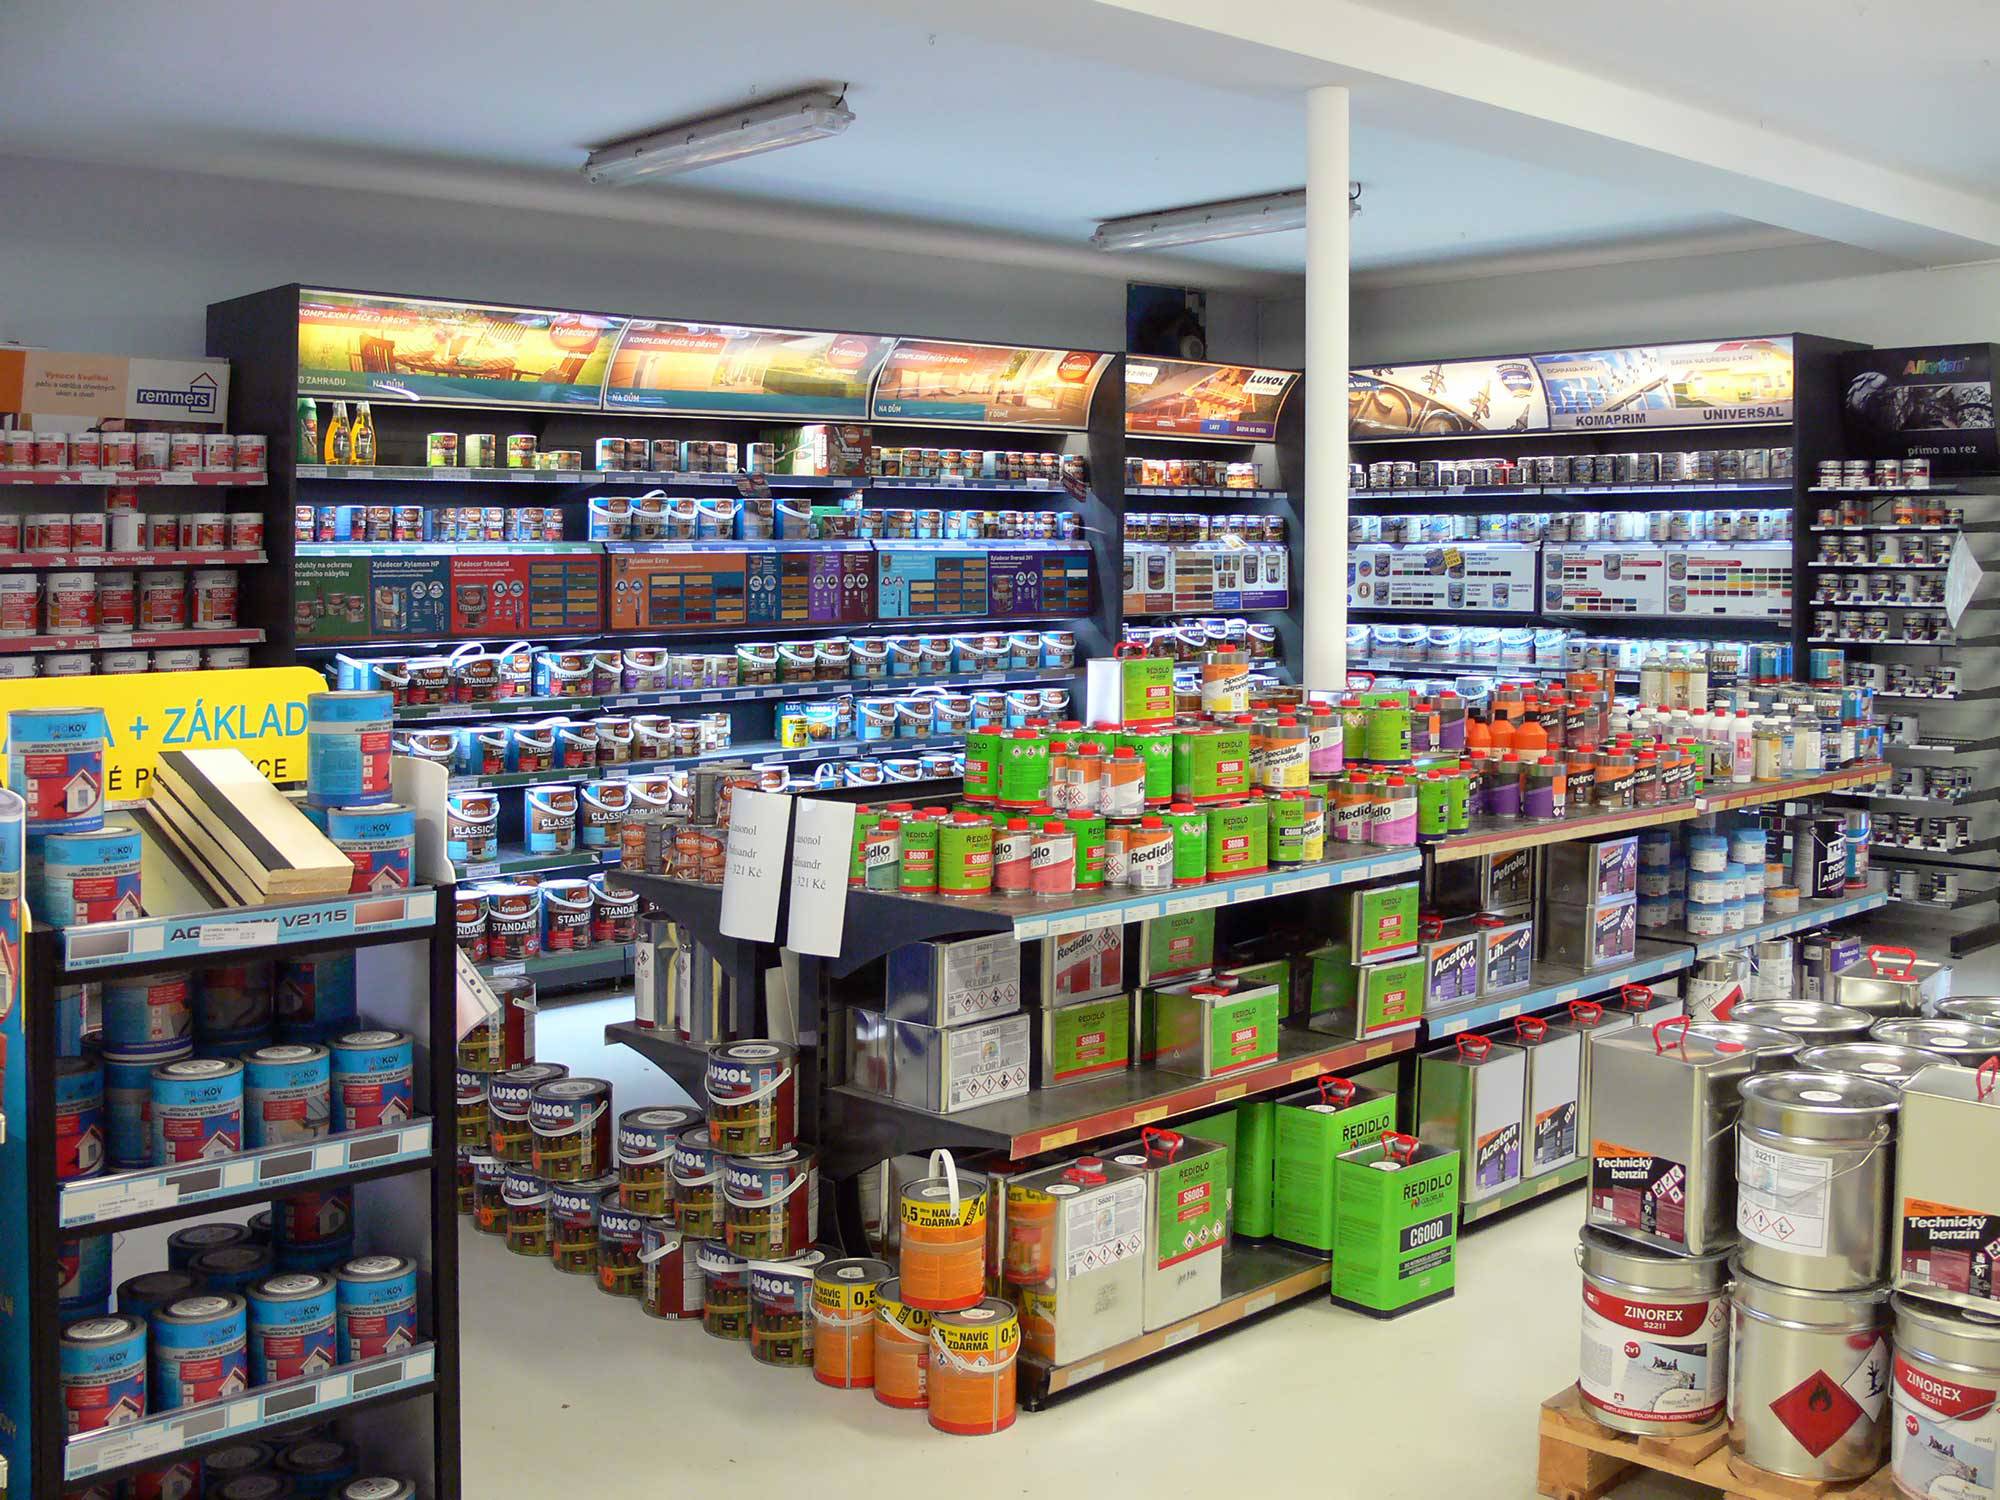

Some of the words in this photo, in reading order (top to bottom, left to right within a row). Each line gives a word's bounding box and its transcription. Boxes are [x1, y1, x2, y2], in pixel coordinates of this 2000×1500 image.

[1250, 374, 1285, 387] LUXOL
[139, 389, 208, 406] remmers
[1575, 413, 1646, 427] KOMAPRIM
[1703, 406, 1784, 421] UNIVERSAL
[1943, 446, 1957, 455] na
[1960, 445, 1977, 455] rez
[295, 562, 316, 571] odukty
[373, 561, 401, 570] Xyladecor
[430, 561, 440, 569] HP
[464, 676, 498, 685] STANDARD
[162, 698, 309, 745] ZÁKLAD
[1567, 773, 1594, 787] Petro
[1338, 802, 1372, 821] Ředid
[453, 825, 490, 835] CLASSIC
[732, 826, 757, 837] asonol
[796, 833, 821, 846] asonol
[748, 867, 762, 878] Kč
[1493, 852, 1528, 884] Petrolej
[812, 880, 826, 891] Kč
[456, 907, 477, 917] yladecor
[501, 902, 527, 913] Xyladecor
[600, 904, 638, 917] STANDA
[282, 909, 347, 927] V2115
[558, 912, 591, 924] STANDA
[457, 924, 485, 935] NDARD
[492, 920, 536, 933] STANDARD
[1434, 940, 1474, 976] Aceton
[1488, 945, 1504, 964] Líh
[971, 1057, 1011, 1074] COLORLAK
[457, 1073, 480, 1086] XOL
[708, 1065, 750, 1084] UXOL
[1342, 1114, 1390, 1143] ŘEDIDLO
[619, 1129, 657, 1148] UXOL
[1480, 1125, 1516, 1165] Aceton
[1755, 1149, 1776, 1164] S2211
[479, 1163, 506, 1175] LUX
[1597, 1157, 1653, 1171] Technický
[726, 1168, 763, 1188] UXOL
[1611, 1168, 1648, 1181] benzín
[1403, 1171, 1453, 1201] ŘEDIDLO
[1183, 1186, 1205, 1204] S6005
[902, 1202, 918, 1223] 0,5
[601, 1214, 641, 1232] LUXO
[920, 1216, 961, 1227] ZDARMA
[1909, 1216, 1987, 1230] Technický
[1410, 1219, 1443, 1248] C6000
[1929, 1227, 1980, 1240] benzín
[753, 1273, 795, 1296] UXOL
[1624, 1306, 1683, 1322] ZINOREX
[1643, 1320, 1666, 1330] S2211
[959, 1330, 989, 1342] NAVÍC
[947, 1340, 989, 1352] ZDARMA
[1625, 1344, 1640, 1355] 2v1
[1906, 1368, 1961, 1402] ZINOREX
